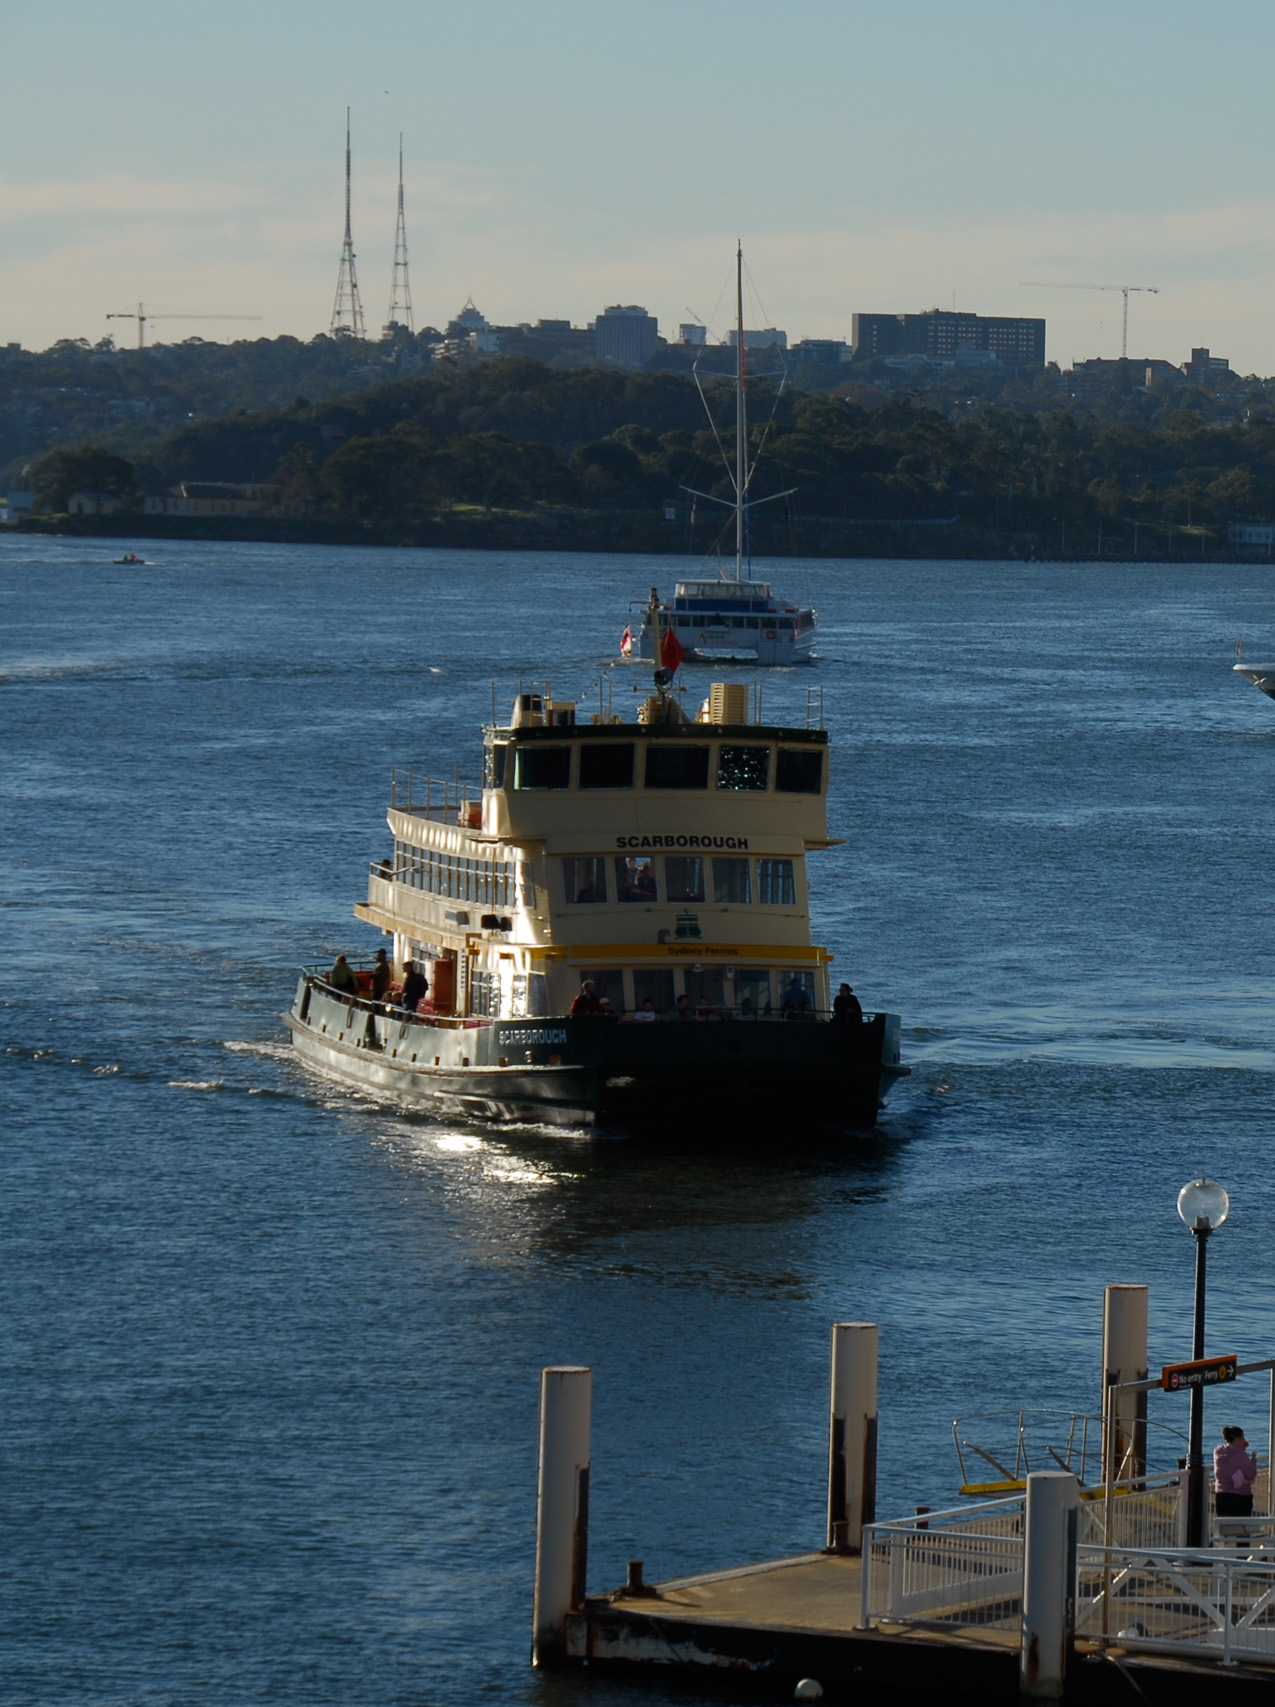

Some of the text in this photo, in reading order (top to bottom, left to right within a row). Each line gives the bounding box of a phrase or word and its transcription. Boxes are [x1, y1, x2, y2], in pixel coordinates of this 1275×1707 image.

[616, 835, 749, 850] SCARBOROUGH
[667, 946, 738, 956] Sydney Ferries
[499, 1029, 567, 1046] SCARBOROUGH
[1179, 1372, 1202, 1384] No entry
[1204, 1370, 1218, 1380] Ferry
